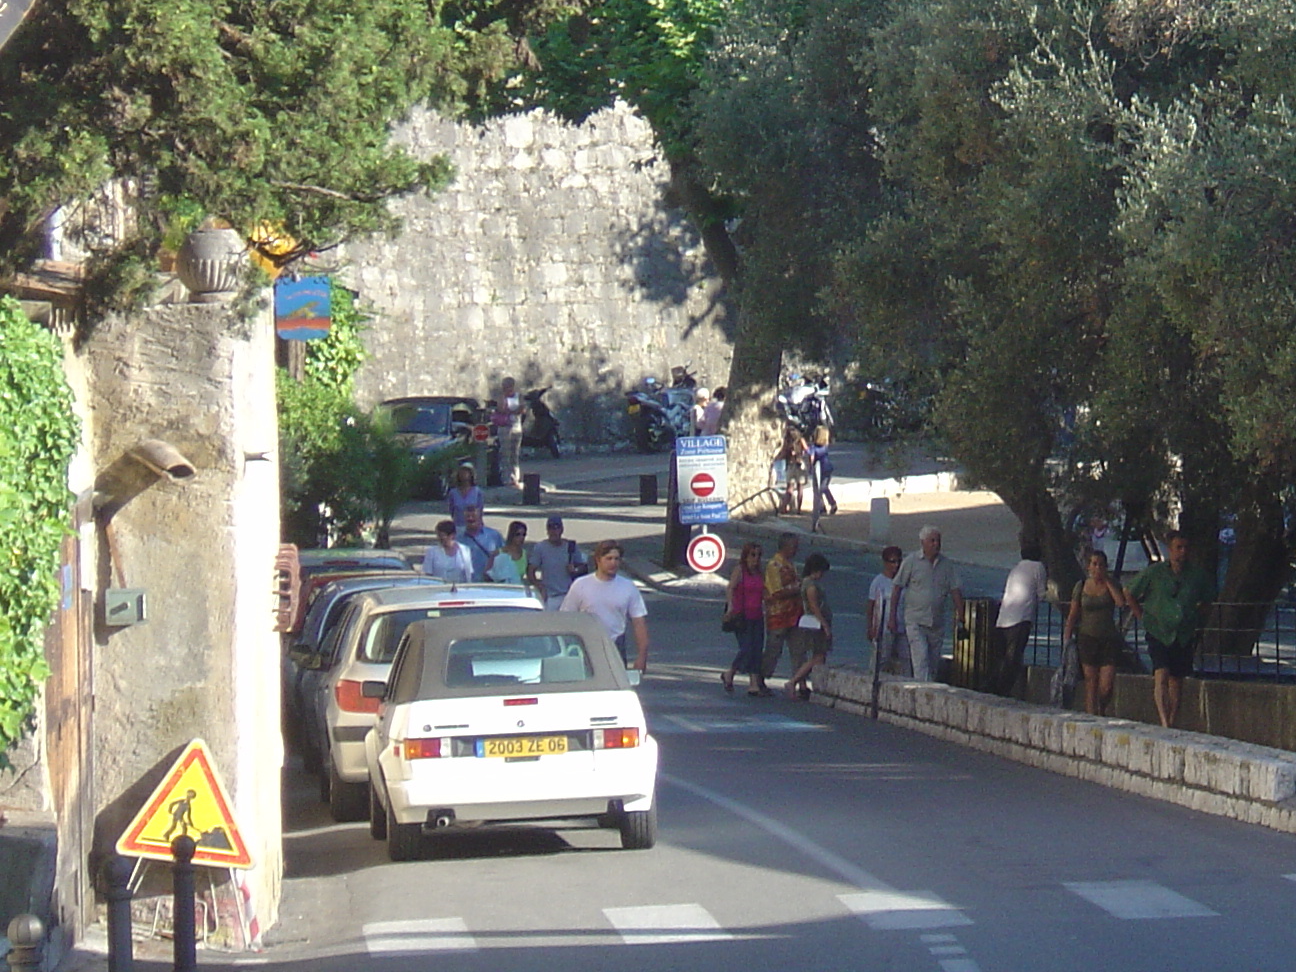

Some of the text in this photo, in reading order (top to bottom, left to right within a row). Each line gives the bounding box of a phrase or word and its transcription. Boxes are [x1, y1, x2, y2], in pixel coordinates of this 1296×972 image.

[680, 438, 723, 449] VILLAGE
[488, 737, 566, 755] 2003 ZE 06
